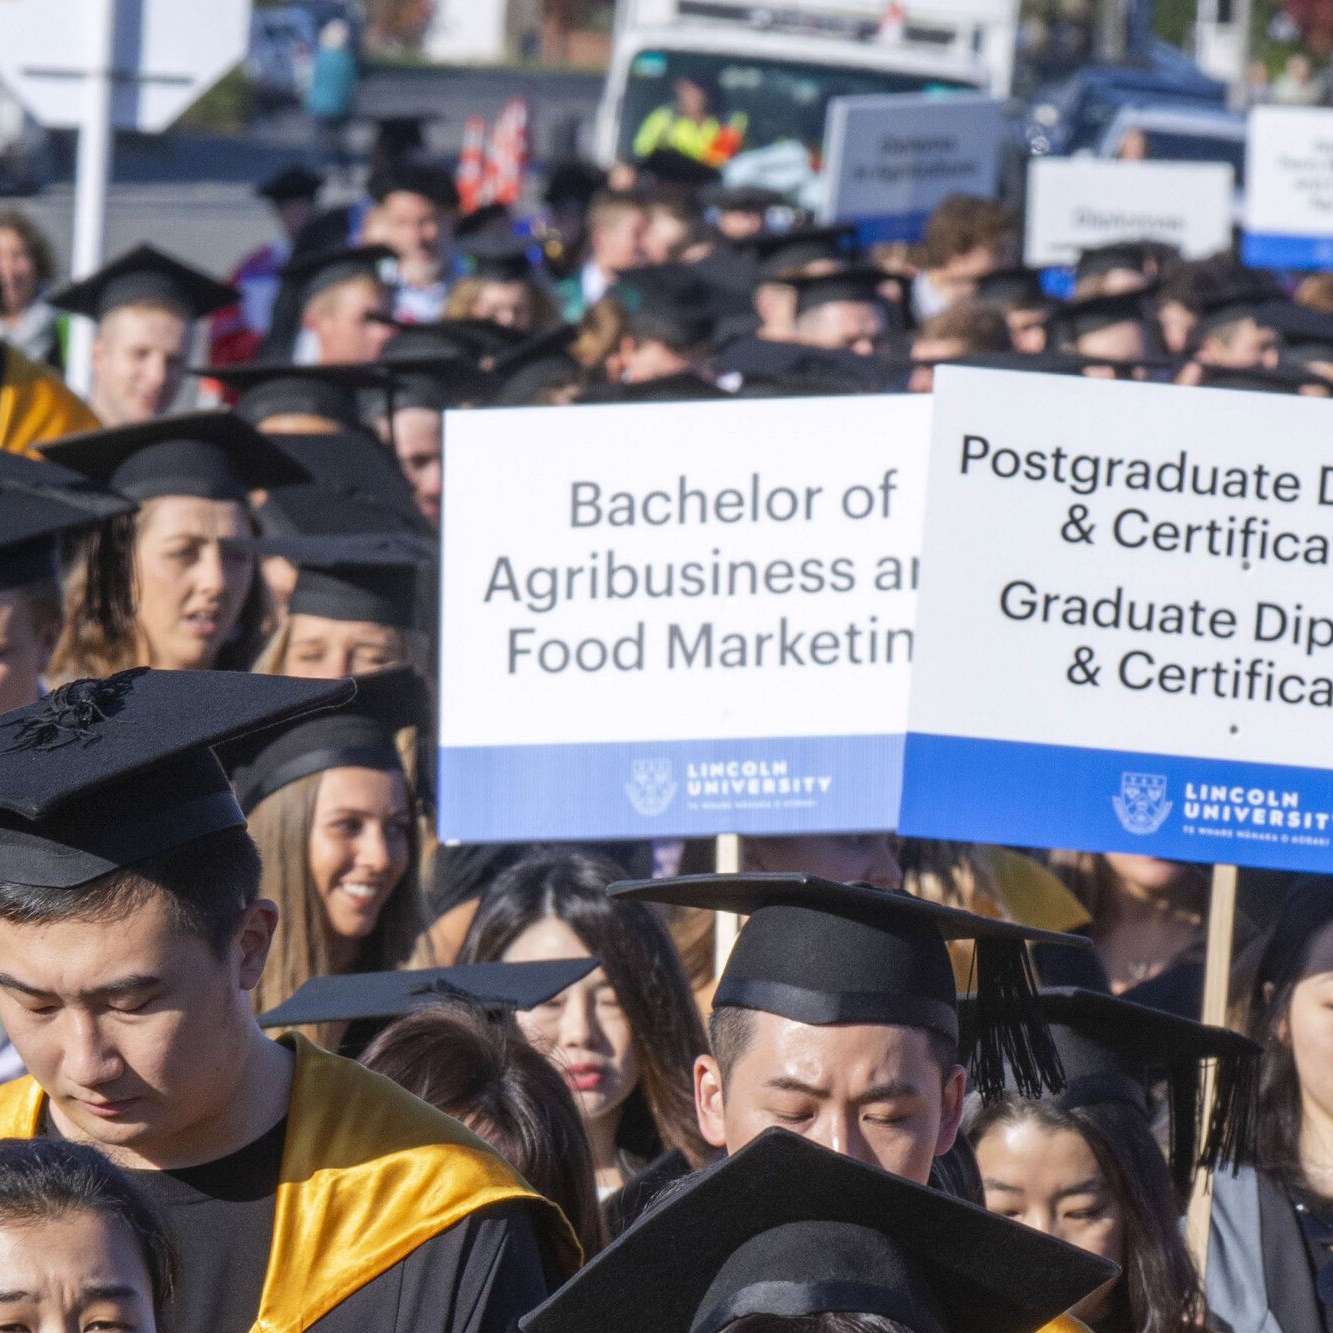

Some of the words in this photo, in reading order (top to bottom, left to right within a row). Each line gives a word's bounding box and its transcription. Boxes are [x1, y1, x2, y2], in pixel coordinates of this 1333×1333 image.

[960, 434, 1301, 503] Postgraduate
[570, 472, 824, 529] Bachelor
[841, 468, 898, 520] of
[1060, 503, 1097, 545] &
[482, 547, 856, 614] Agribusiness
[999, 579, 1238, 640] Graduate
[507, 620, 645, 675] Food
[667, 615, 915, 670] Marketin
[1066, 645, 1102, 687] &
[687, 760, 788, 779] LINCOLN
[687, 776, 832, 796] UNIVERSITY
[1185, 782, 1299, 808] LINCOLN
